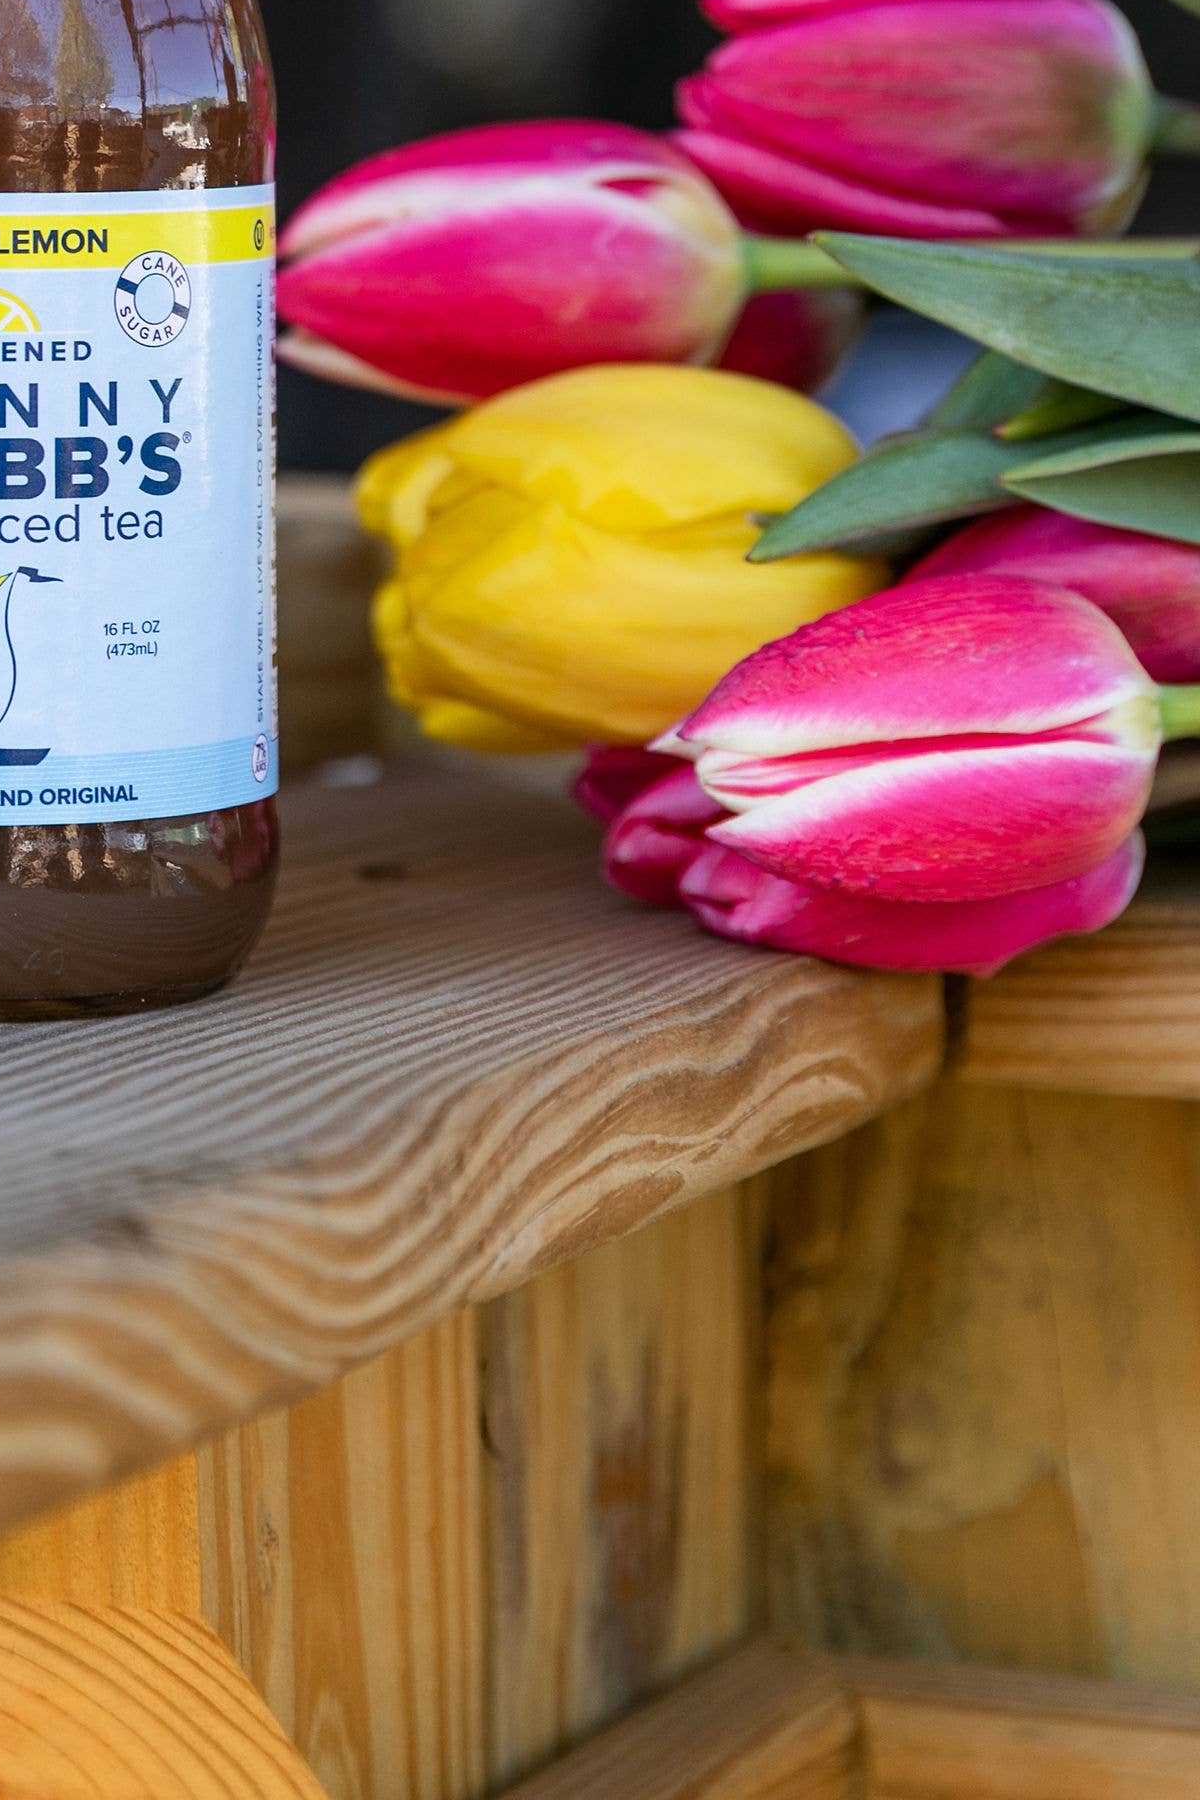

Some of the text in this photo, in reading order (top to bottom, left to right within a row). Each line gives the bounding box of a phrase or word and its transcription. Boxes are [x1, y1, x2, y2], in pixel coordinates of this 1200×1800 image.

[141, 256, 186, 288] CANE
[119, 305, 174, 342] SUGAR
[100, 505, 163, 541] tea
[103, 620, 160, 636] 16 FL OZ
[106, 641, 158, 660] (473mL)
[39, 784, 138, 805] ORIGINAL
